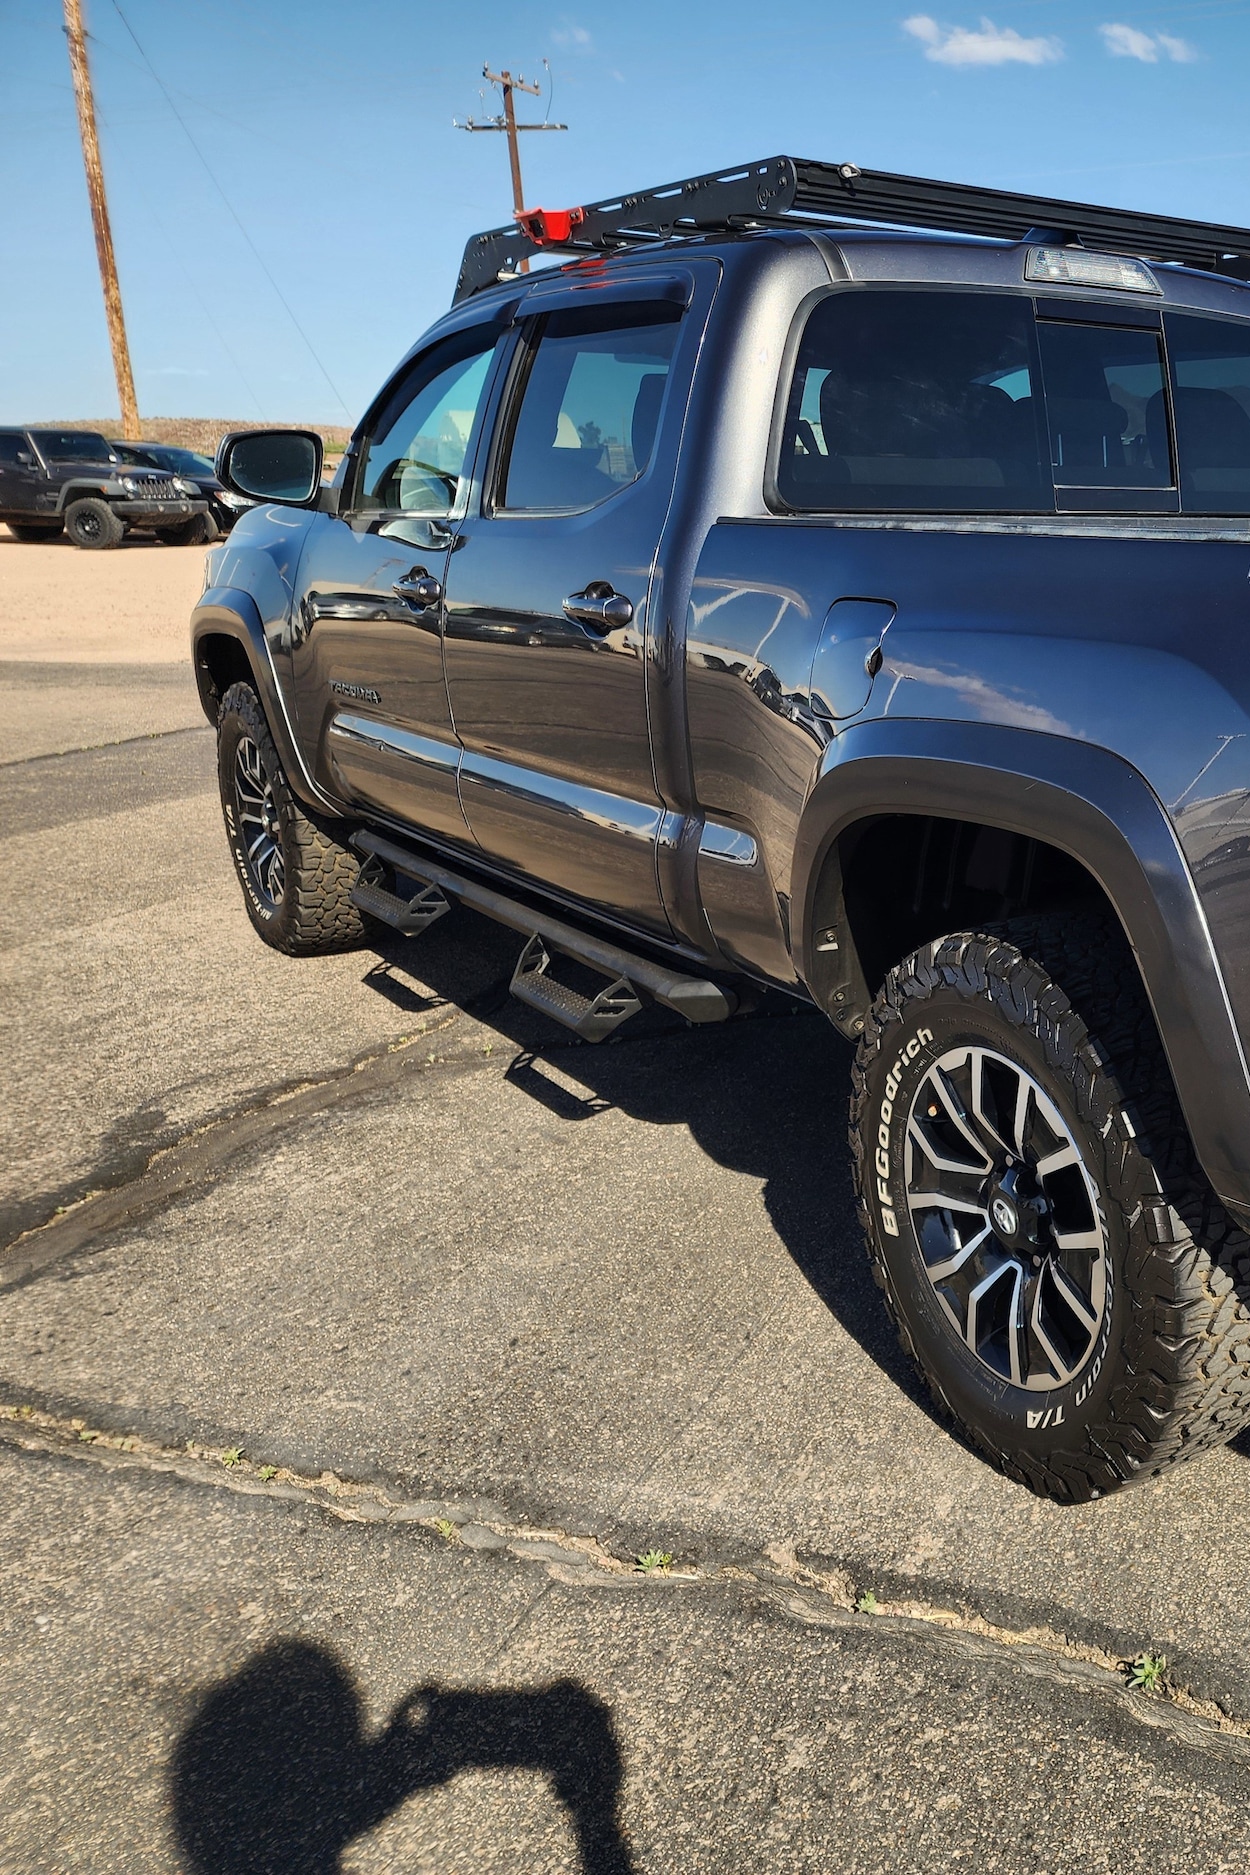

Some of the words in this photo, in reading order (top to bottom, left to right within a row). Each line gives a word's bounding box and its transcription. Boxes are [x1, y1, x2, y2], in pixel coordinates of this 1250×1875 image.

[327, 680, 382, 705] TACOMA
[875, 1026, 935, 1238] BFGoodrich
[1026, 1404, 1065, 1429] T/A
